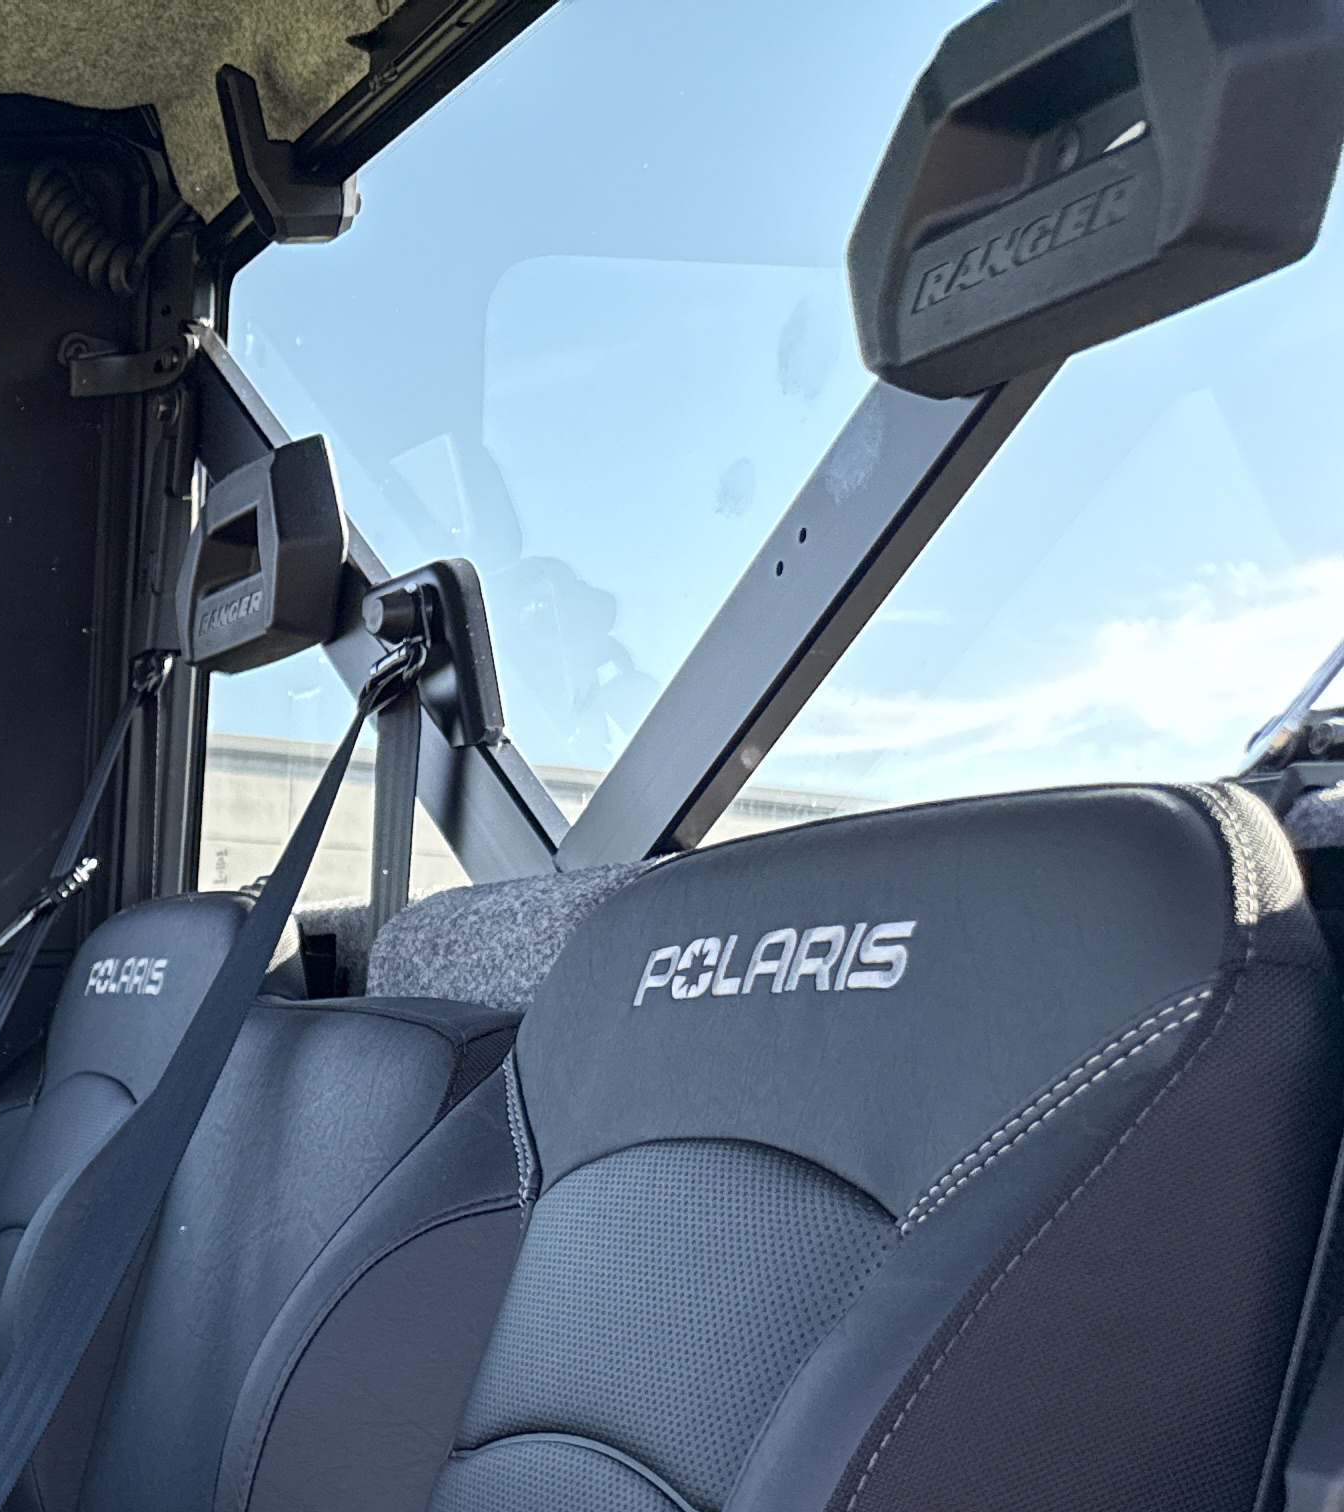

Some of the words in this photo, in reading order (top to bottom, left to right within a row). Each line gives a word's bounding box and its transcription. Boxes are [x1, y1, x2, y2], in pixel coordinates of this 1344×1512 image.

[910, 174, 1136, 316] RANGER
[198, 590, 262, 638] RANGER
[84, 956, 168, 997] POLARIS
[632, 920, 917, 1007] POLARIS
